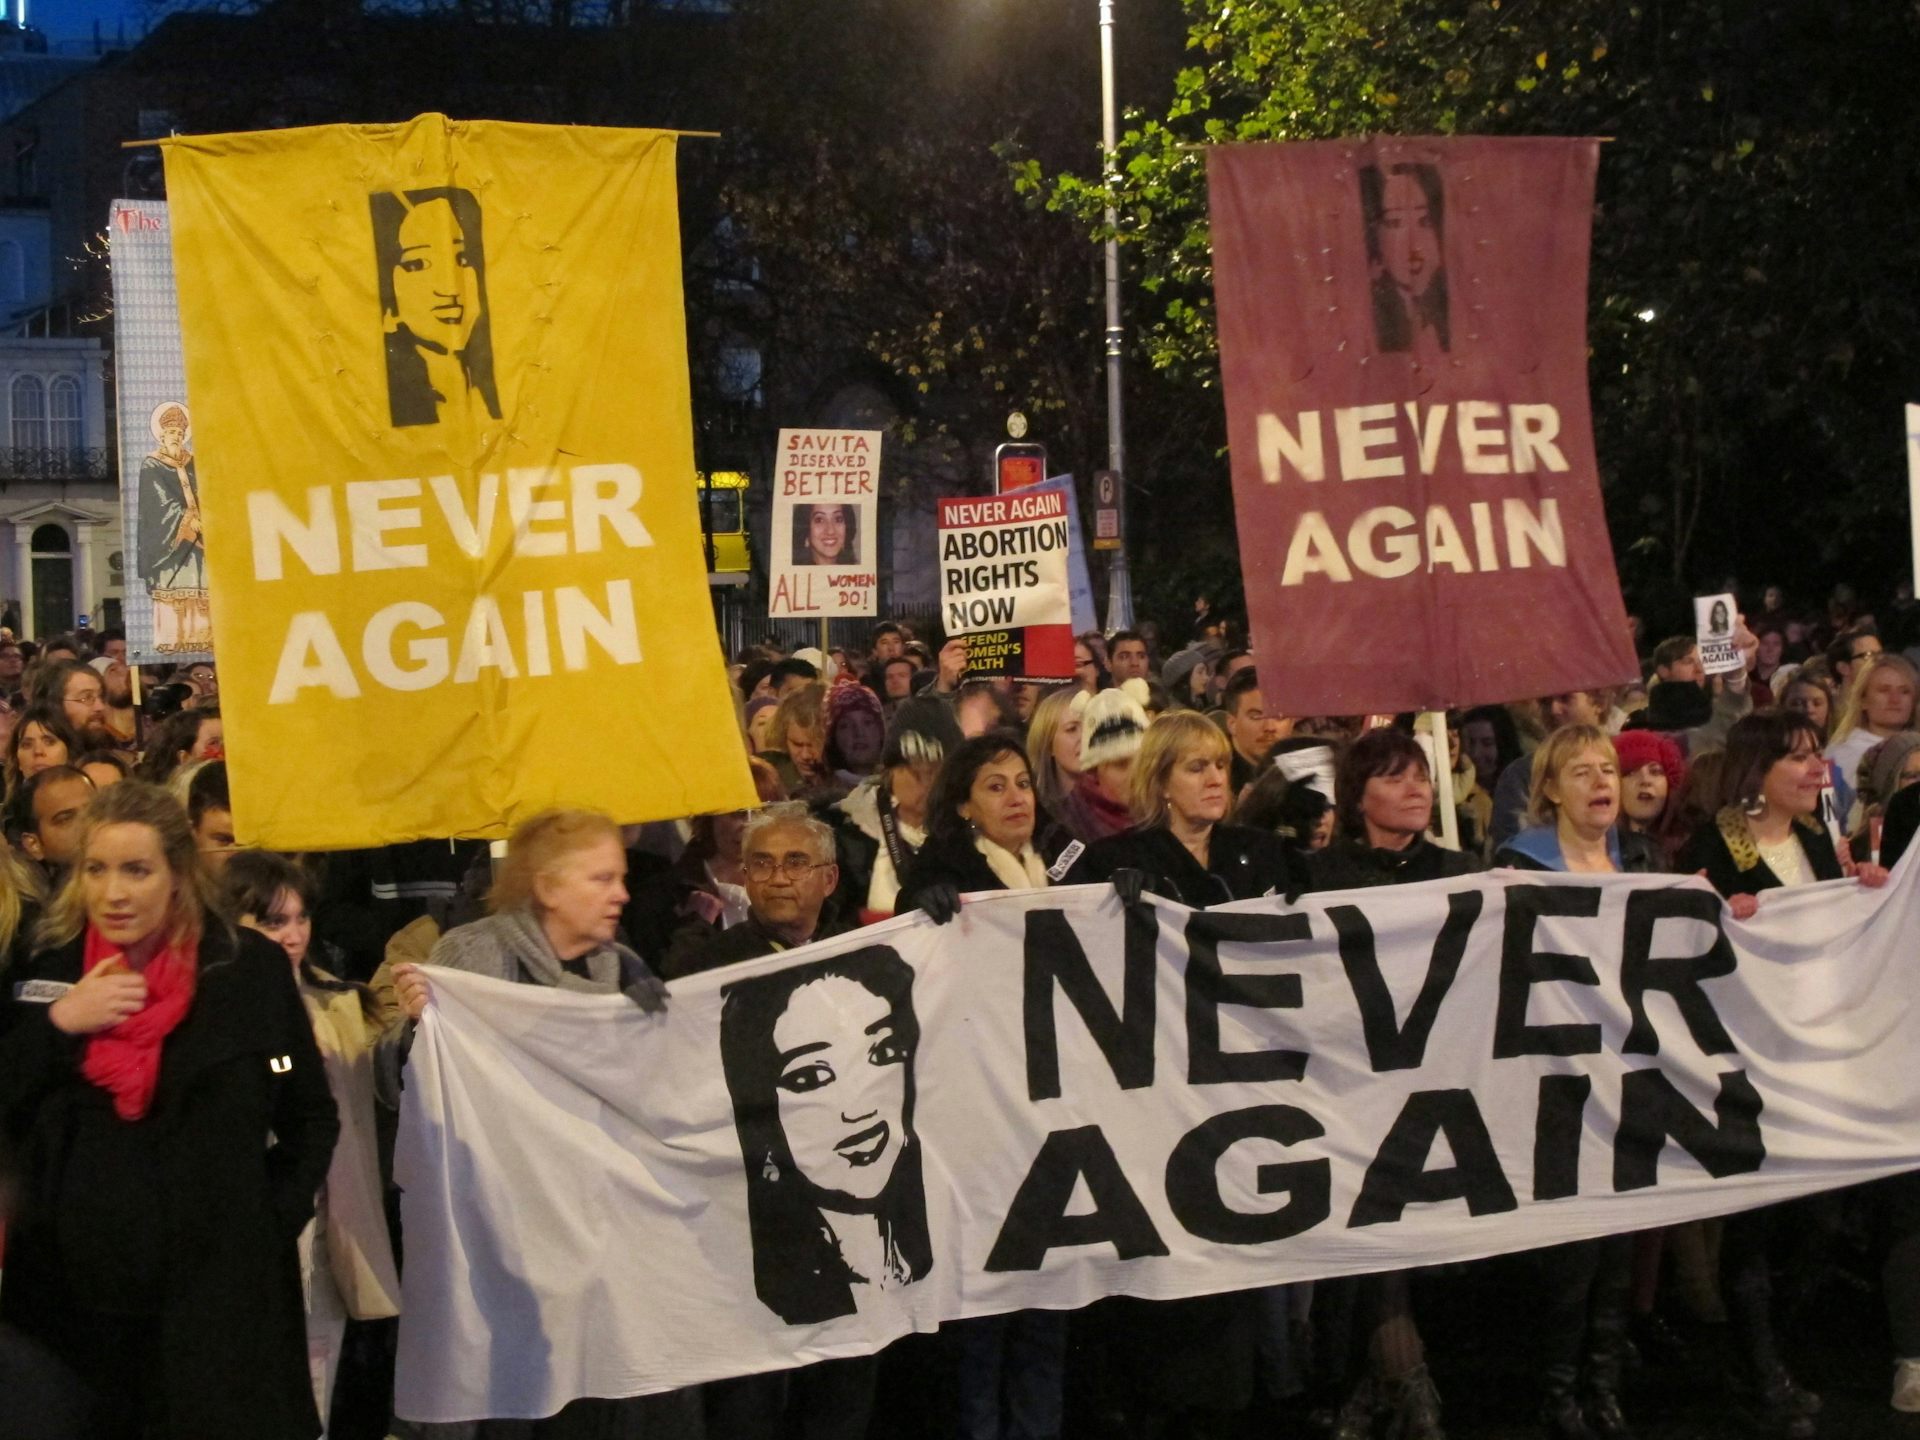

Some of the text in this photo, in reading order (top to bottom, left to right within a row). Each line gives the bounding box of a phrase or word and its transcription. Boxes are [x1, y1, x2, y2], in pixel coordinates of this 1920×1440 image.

[116, 205, 161, 235] The
[787, 434, 870, 453] SAVITA
[1256, 400, 1570, 484] NEVER
[789, 453, 867, 468] DESERVED
[783, 470, 874, 496] BETTER
[246, 462, 656, 581] NEVER
[944, 493, 1062, 526] NEVER AGAIN
[943, 520, 1068, 562] ABORTION
[1280, 498, 1567, 586] AGAIN
[771, 573, 876, 613] ALL WOMEN
[946, 560, 1039, 596] RIGHTS
[838, 590, 868, 610] DO!
[948, 596, 1016, 630] NOW
[267, 578, 643, 705] AGAIN
[961, 632, 1009, 646] FEND
[964, 642, 1022, 659] OMEN'S
[1701, 643, 1732, 654] NEVE
[968, 657, 1004, 671] ALTH
[1023, 884, 1739, 1101] NEVER
[983, 1067, 1766, 1271] AGAIN
